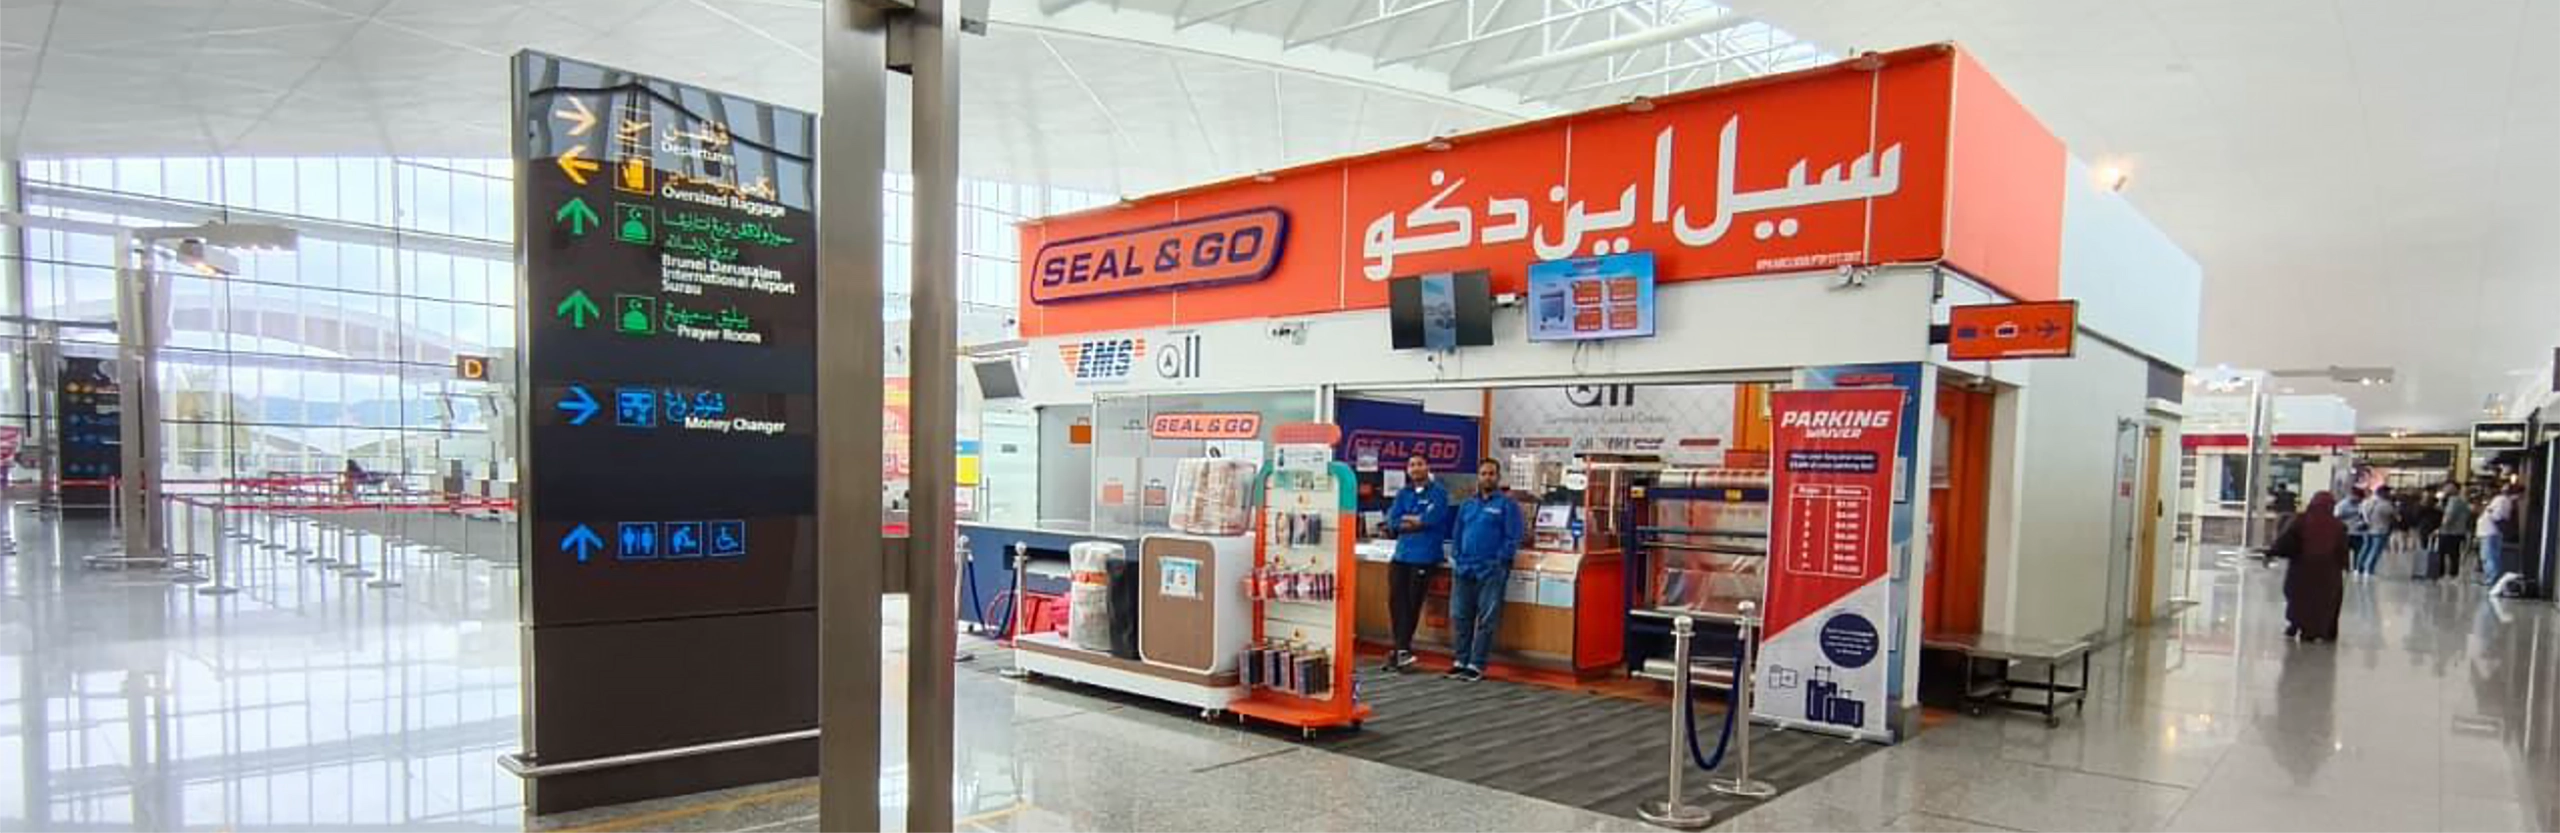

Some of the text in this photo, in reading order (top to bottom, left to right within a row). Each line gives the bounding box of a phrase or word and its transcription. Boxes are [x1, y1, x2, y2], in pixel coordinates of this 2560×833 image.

[661, 140, 735, 166] Departures
[661, 184, 729, 208] Oversized
[661, 253, 707, 272] Brunei
[1042, 225, 1264, 288] SEAL & GO
[661, 265, 796, 296] International Airport
[661, 281, 703, 296] Surau
[677, 323, 762, 344] Prayer Room
[464, 358, 483, 379] D
[1076, 339, 1134, 379] EMS
[685, 416, 787, 435] Money Changer
[1155, 417, 1254, 433] SEAL & GO
[1781, 410, 1892, 428] PARKING
